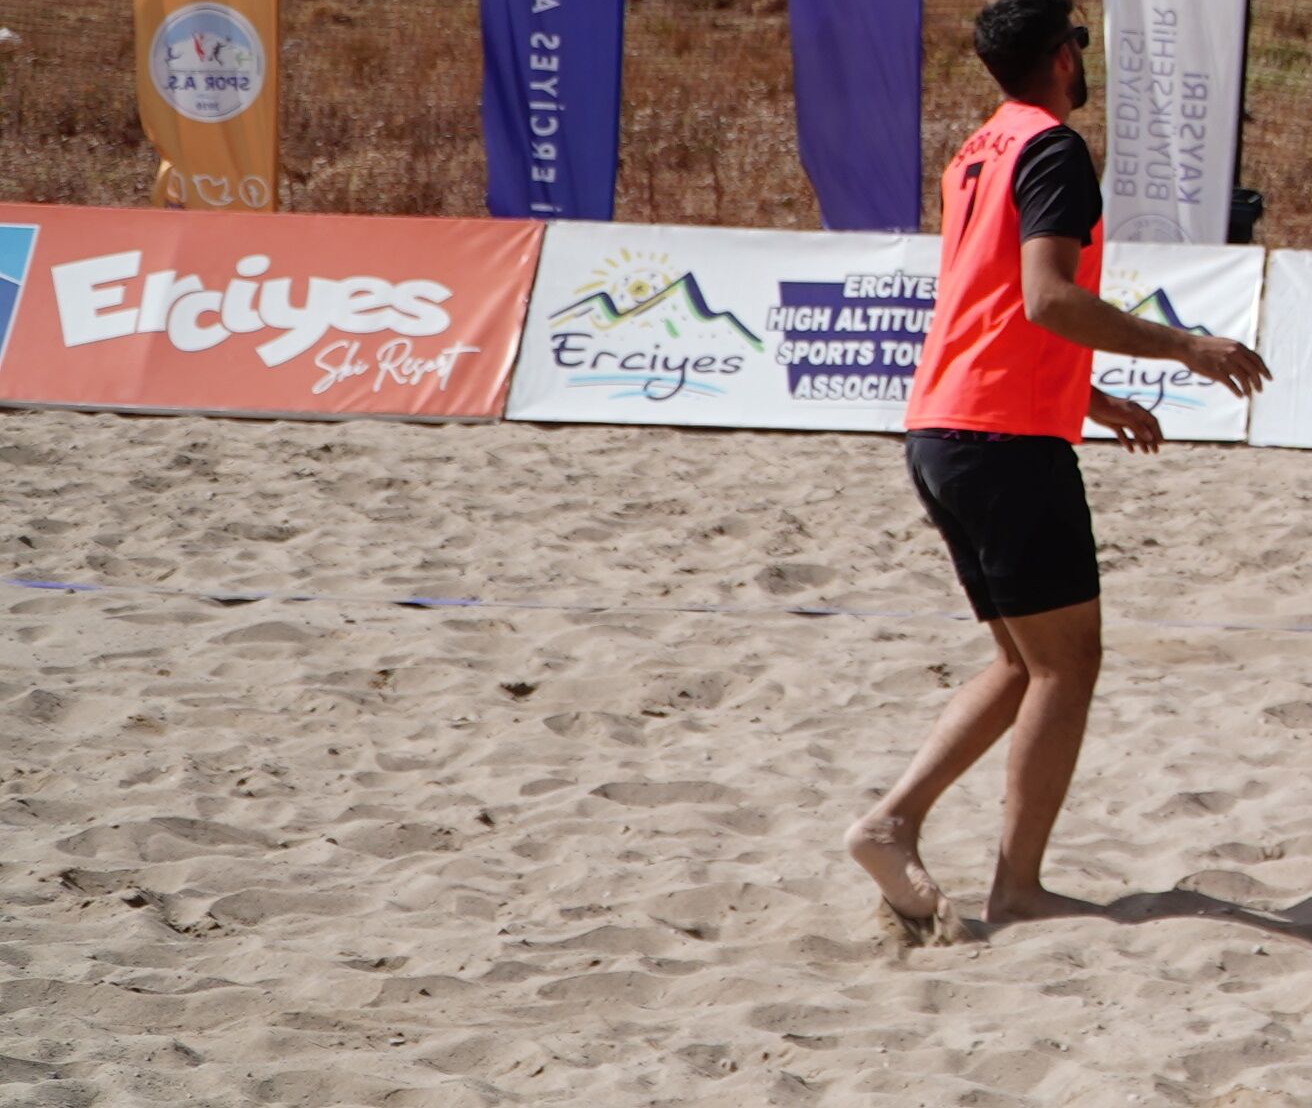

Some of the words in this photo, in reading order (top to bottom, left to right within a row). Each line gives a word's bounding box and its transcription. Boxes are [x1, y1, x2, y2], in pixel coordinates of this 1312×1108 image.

[51, 249, 453, 367] Erciyes
[766, 306, 832, 332] HIGH
[313, 339, 369, 395] Ski
[375, 339, 481, 391] Resort
[551, 332, 744, 400] Erciyes
[775, 340, 875, 367] SPORTS
